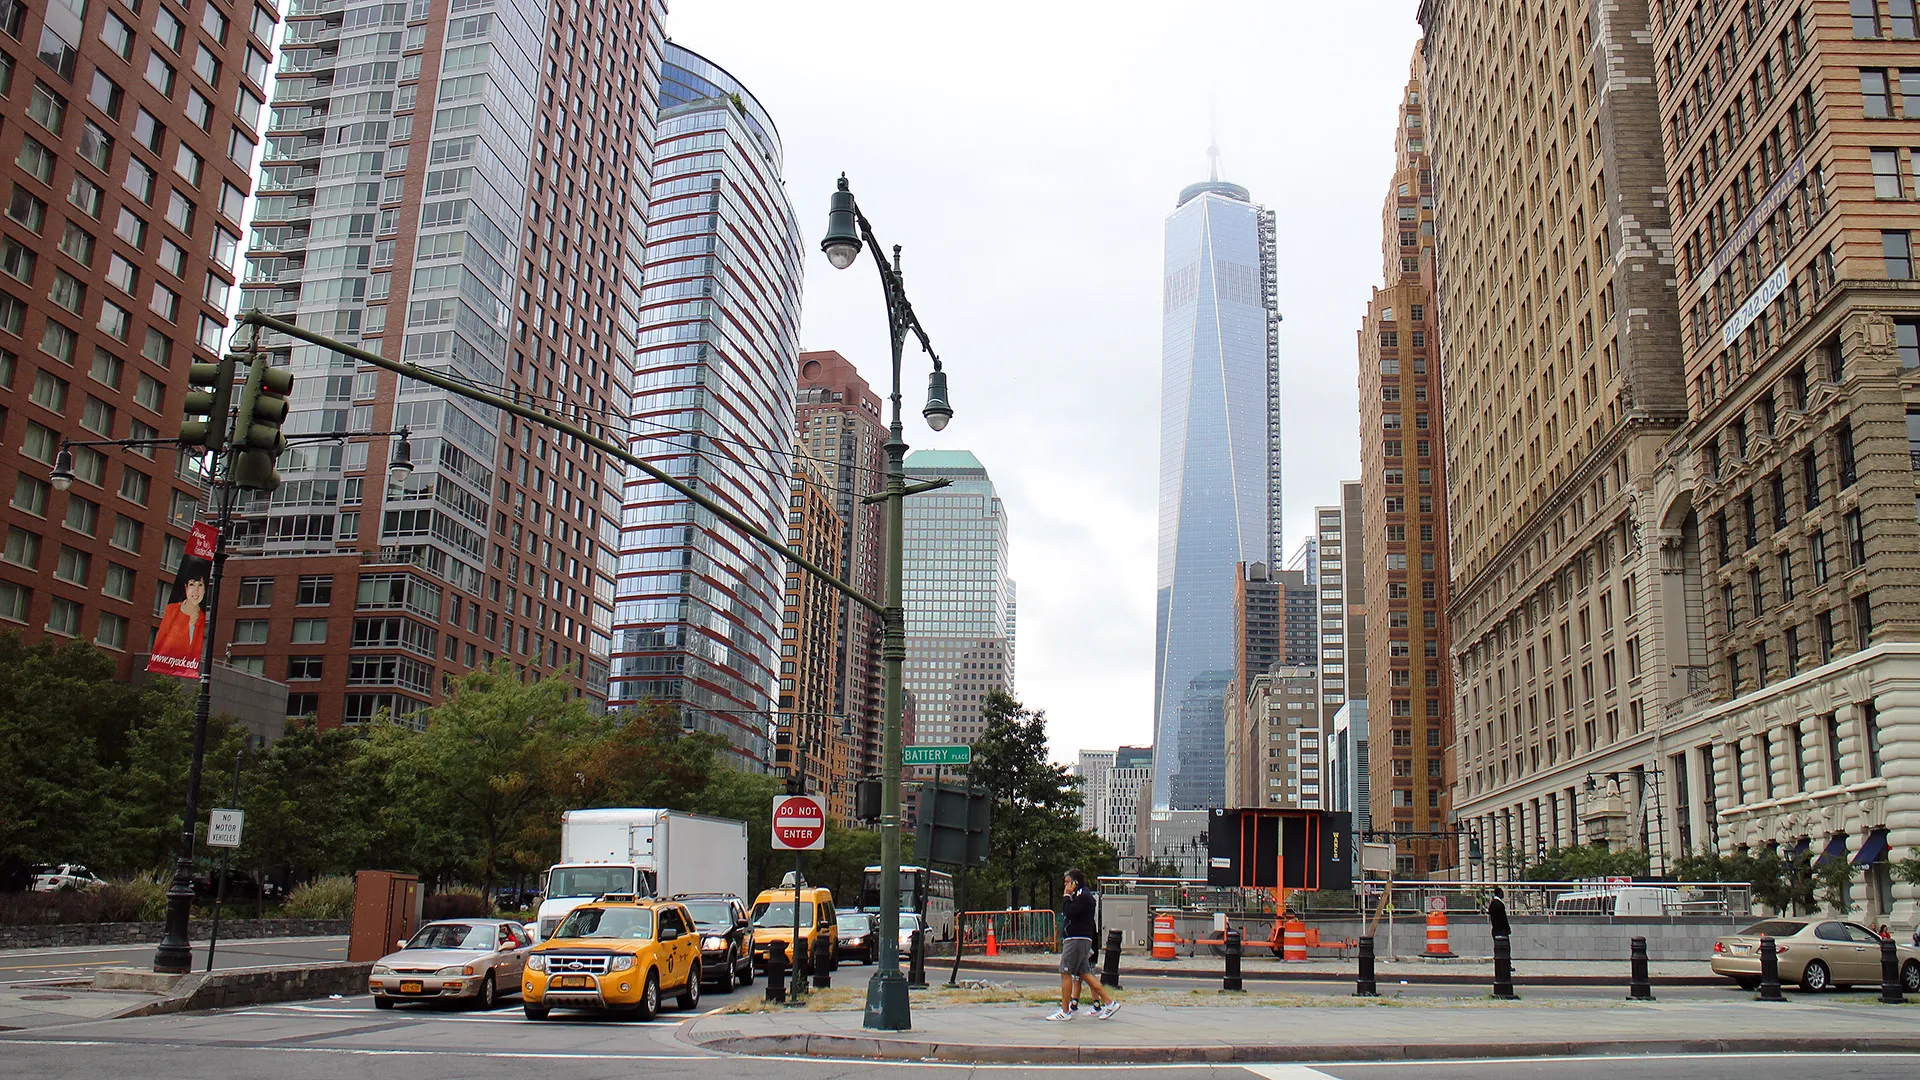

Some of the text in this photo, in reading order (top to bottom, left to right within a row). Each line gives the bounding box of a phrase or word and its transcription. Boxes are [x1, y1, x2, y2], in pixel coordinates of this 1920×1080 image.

[1717, 166, 1801, 271] LUXURY RENTALS
[151, 653, 199, 669] www.nyack.edu
[904, 749, 948, 761] BATTERY
[781, 806, 817, 816] DO NOT
[215, 824, 237, 832] MOTOR
[212, 833, 236, 842] VEHICLES
[783, 829, 813, 839] ENTER
